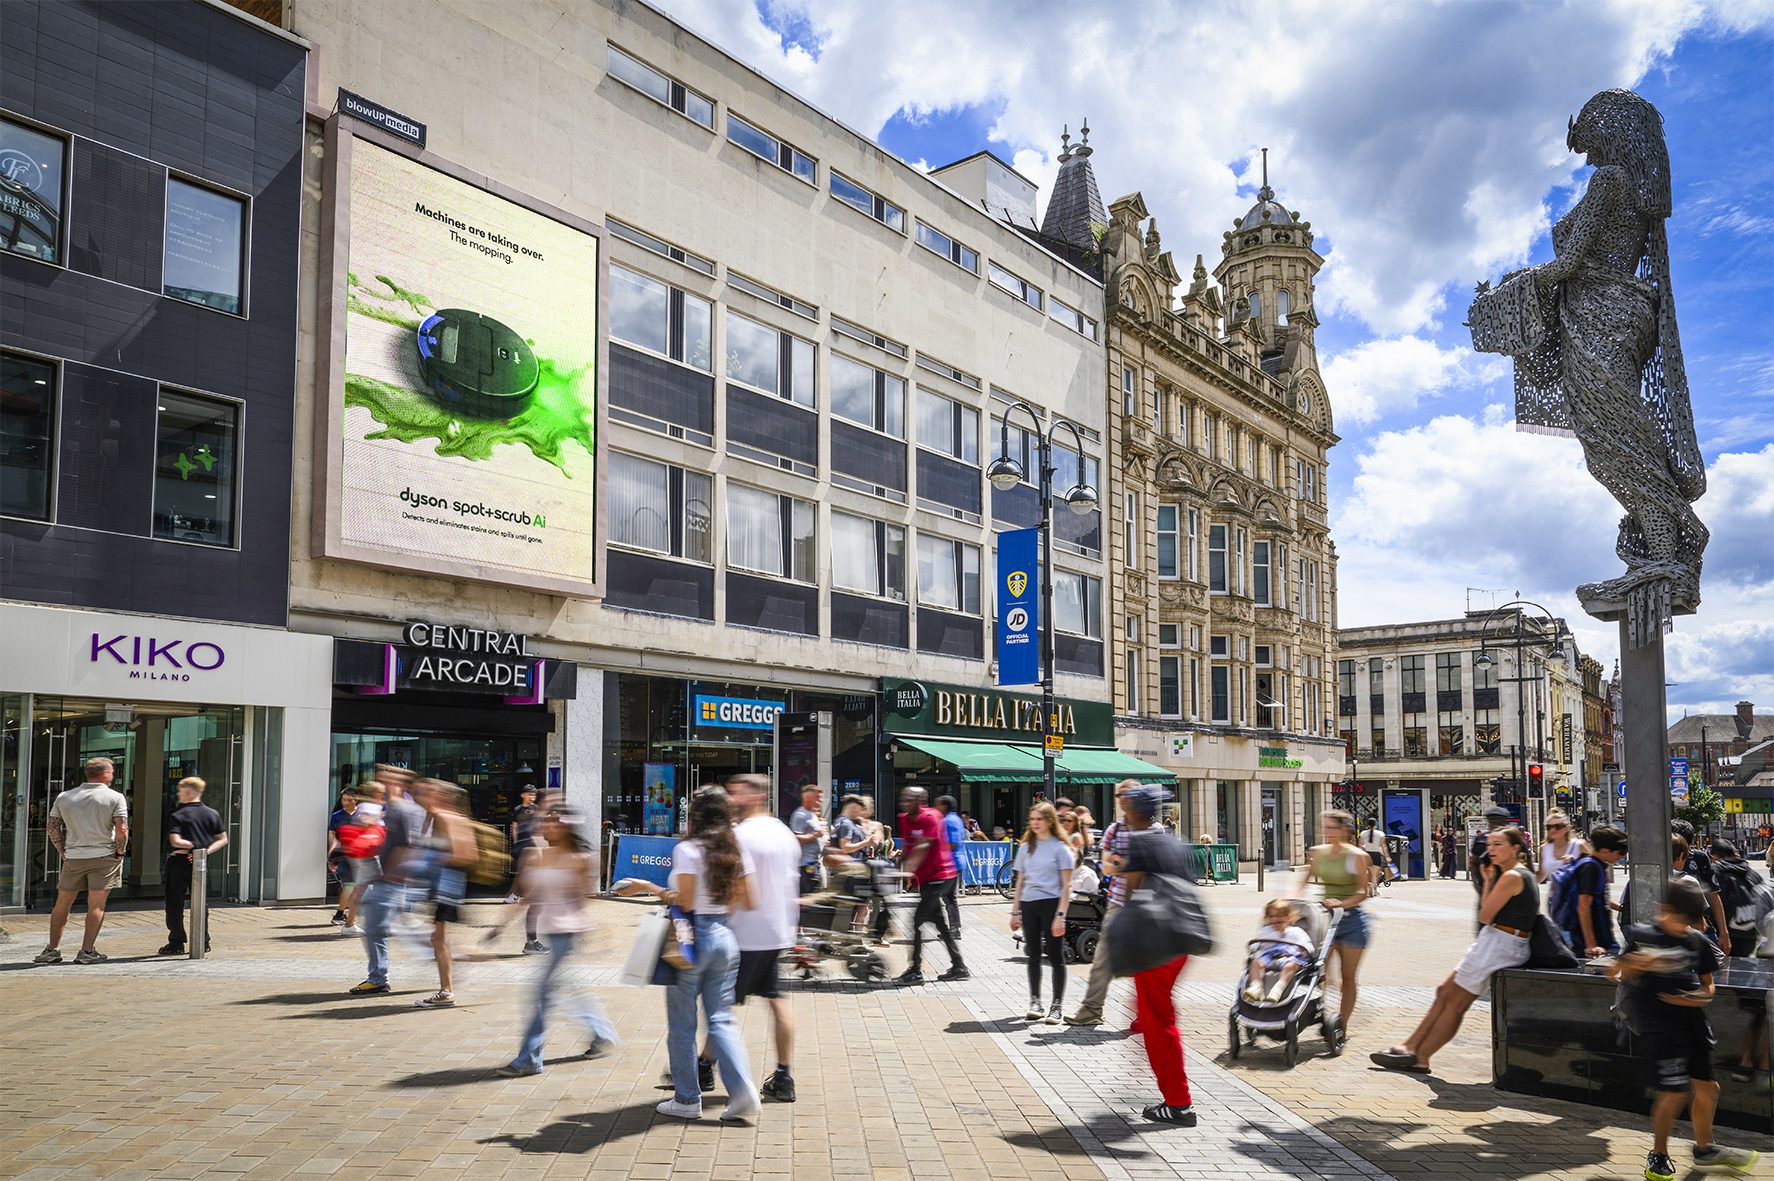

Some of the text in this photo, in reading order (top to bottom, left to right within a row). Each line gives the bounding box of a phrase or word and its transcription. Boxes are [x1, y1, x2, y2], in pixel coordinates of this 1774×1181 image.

[3, 203, 41, 221] LEEDS
[415, 202, 545, 262] Machines are taking over.
[449, 229, 514, 265] The mopping.
[400, 487, 546, 529] dyson spot+scrub Ai
[401, 511, 425, 523] Detects
[426, 516, 439, 526] and
[439, 519, 471, 531] eliminates
[471, 524, 488, 534] stains
[488, 528, 500, 537] and
[501, 530, 515, 539] spills
[515, 533, 528, 541] until
[1009, 613, 1026, 627] JD
[90, 632, 225, 671] KIKO
[408, 622, 535, 657] CENTRAL
[129, 670, 190, 682] MILANO
[415, 656, 528, 688] ARCADE
[897, 690, 920, 701] BELLA
[897, 698, 921, 709] ITALIA
[936, 690, 1077, 735] BELLA ITAIA
[1563, 717, 1571, 761] WARHAMMER
[650, 815, 669, 825] HEAT
[640, 855, 672, 867] GREGGS
[979, 857, 1003, 867] GREGGS
[1216, 853, 1231, 863] BELLA
